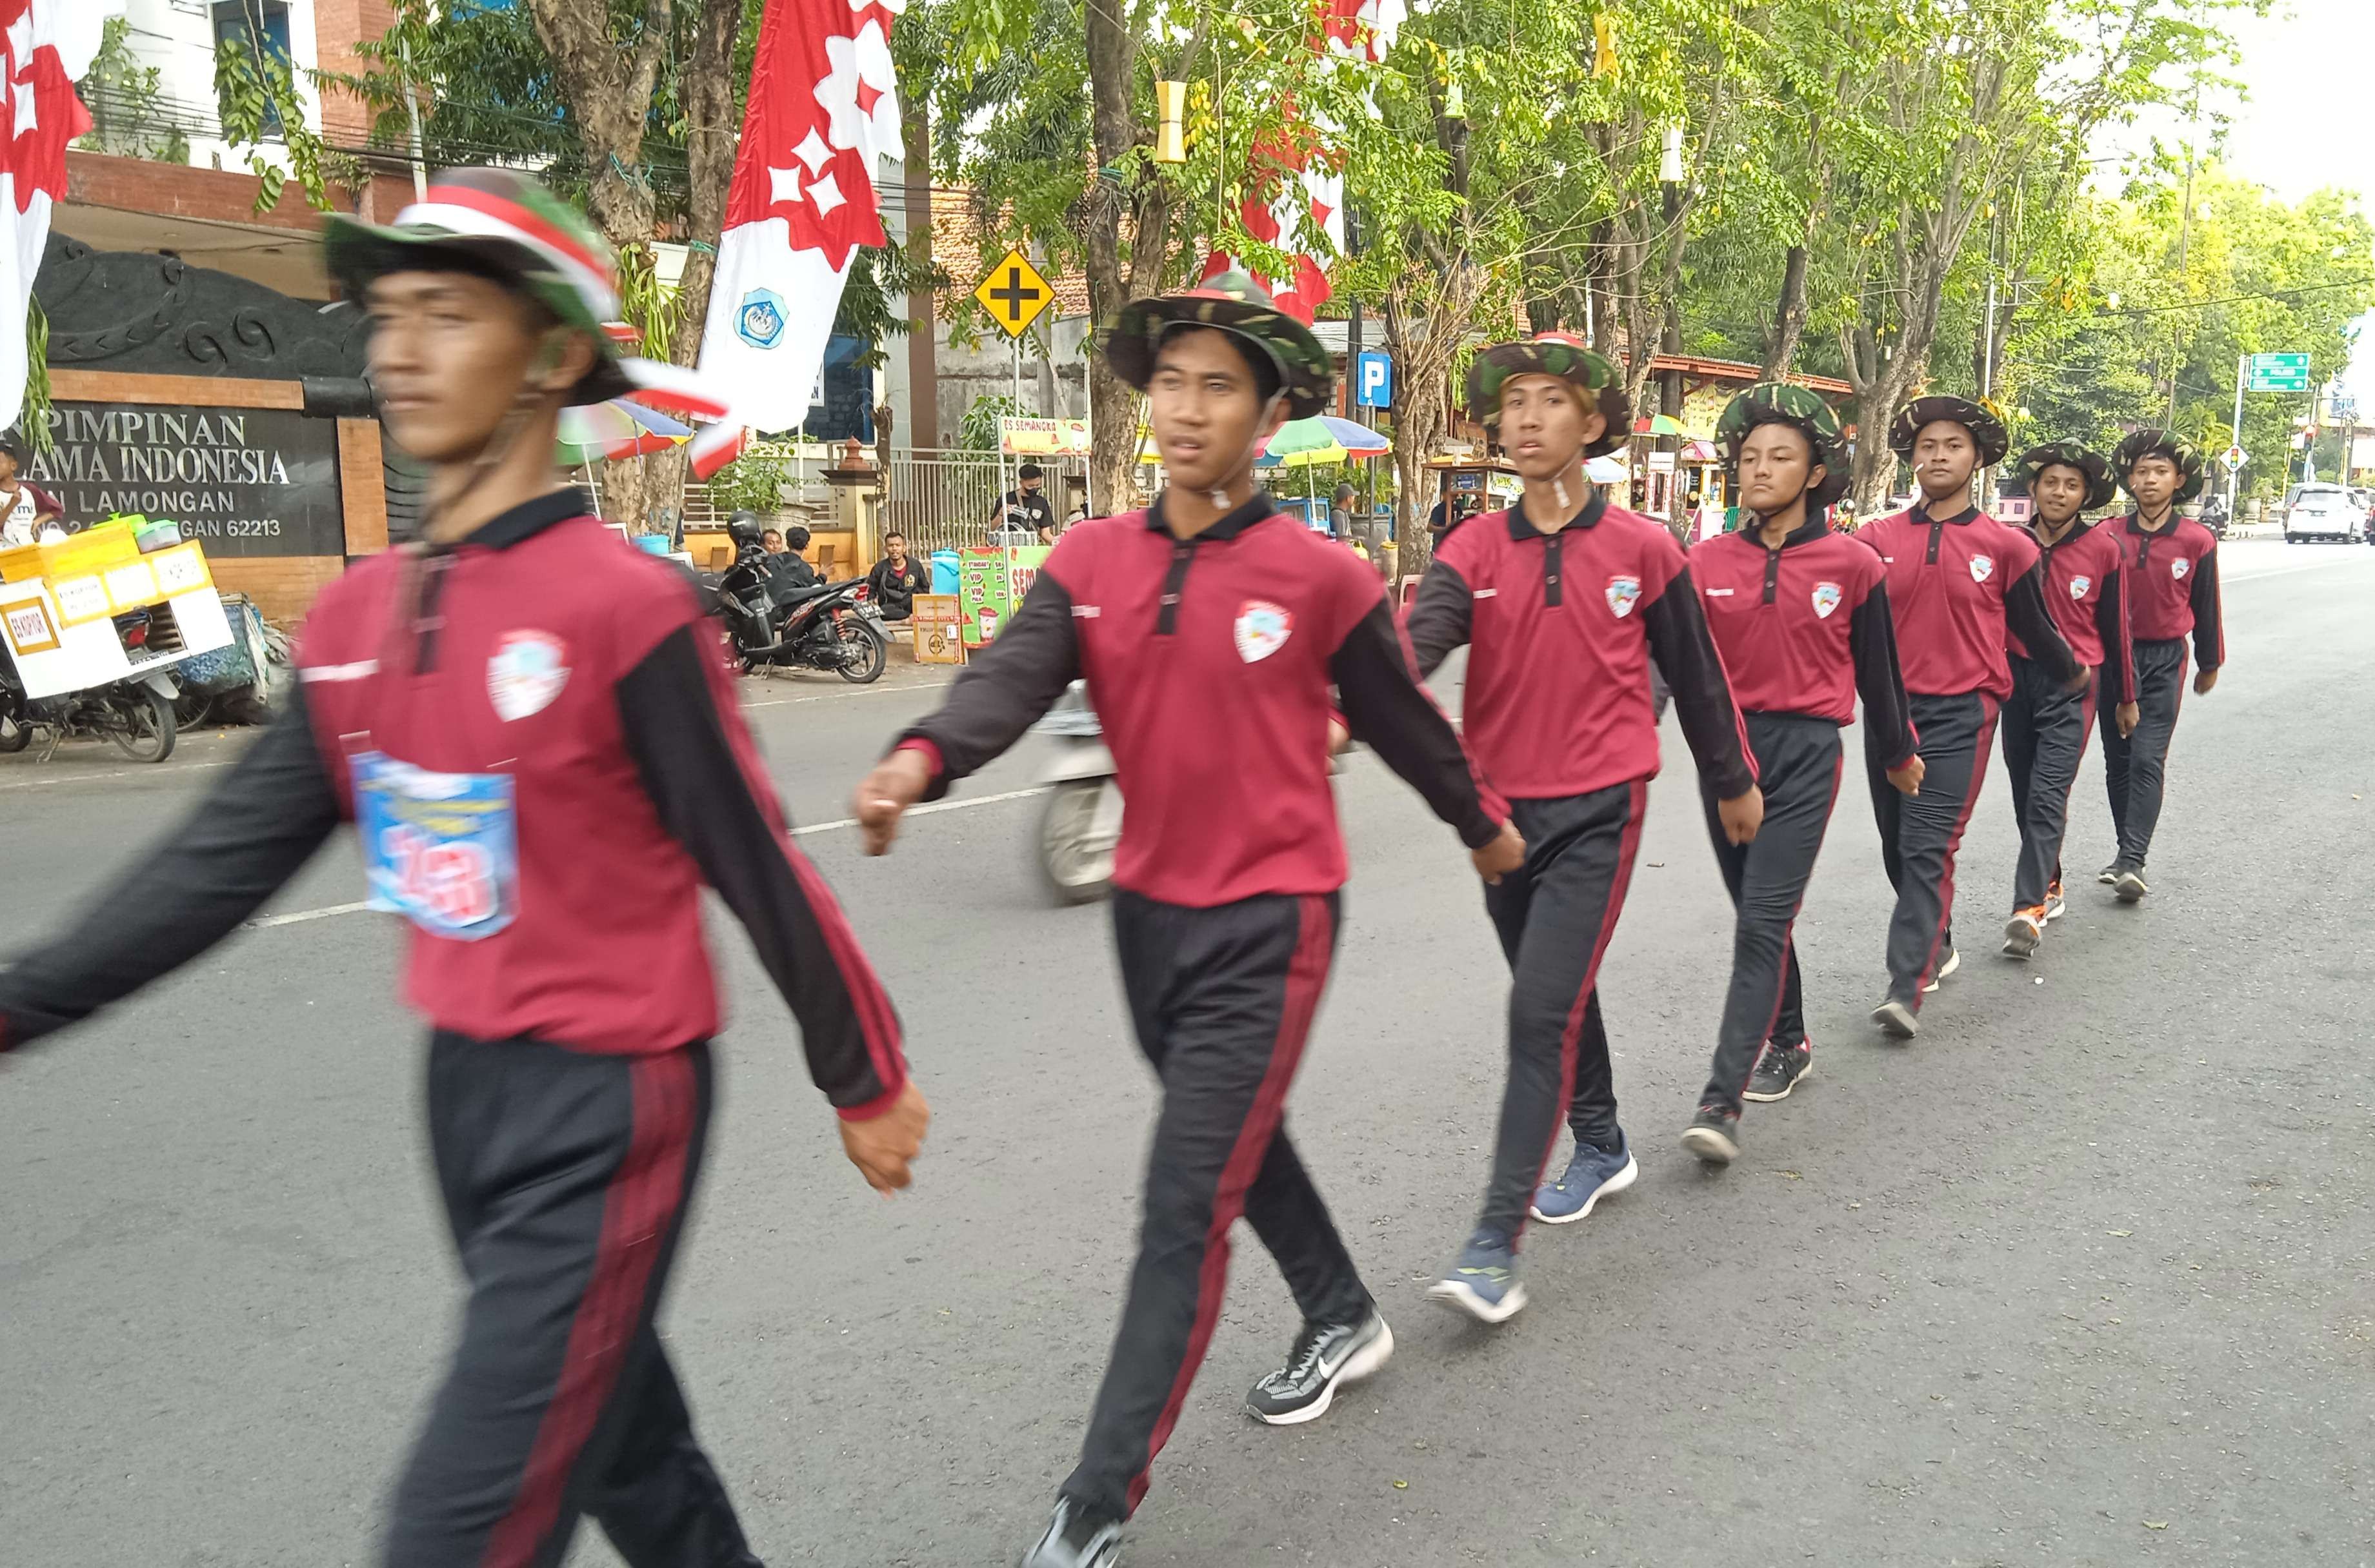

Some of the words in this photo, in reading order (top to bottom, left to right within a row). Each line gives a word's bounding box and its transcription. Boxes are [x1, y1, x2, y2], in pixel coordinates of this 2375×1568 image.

[1364, 361, 1385, 398] P
[119, 446, 290, 484] INDONESIA
[79, 490, 234, 513] LAMONGAN
[227, 519, 281, 537] 62213
